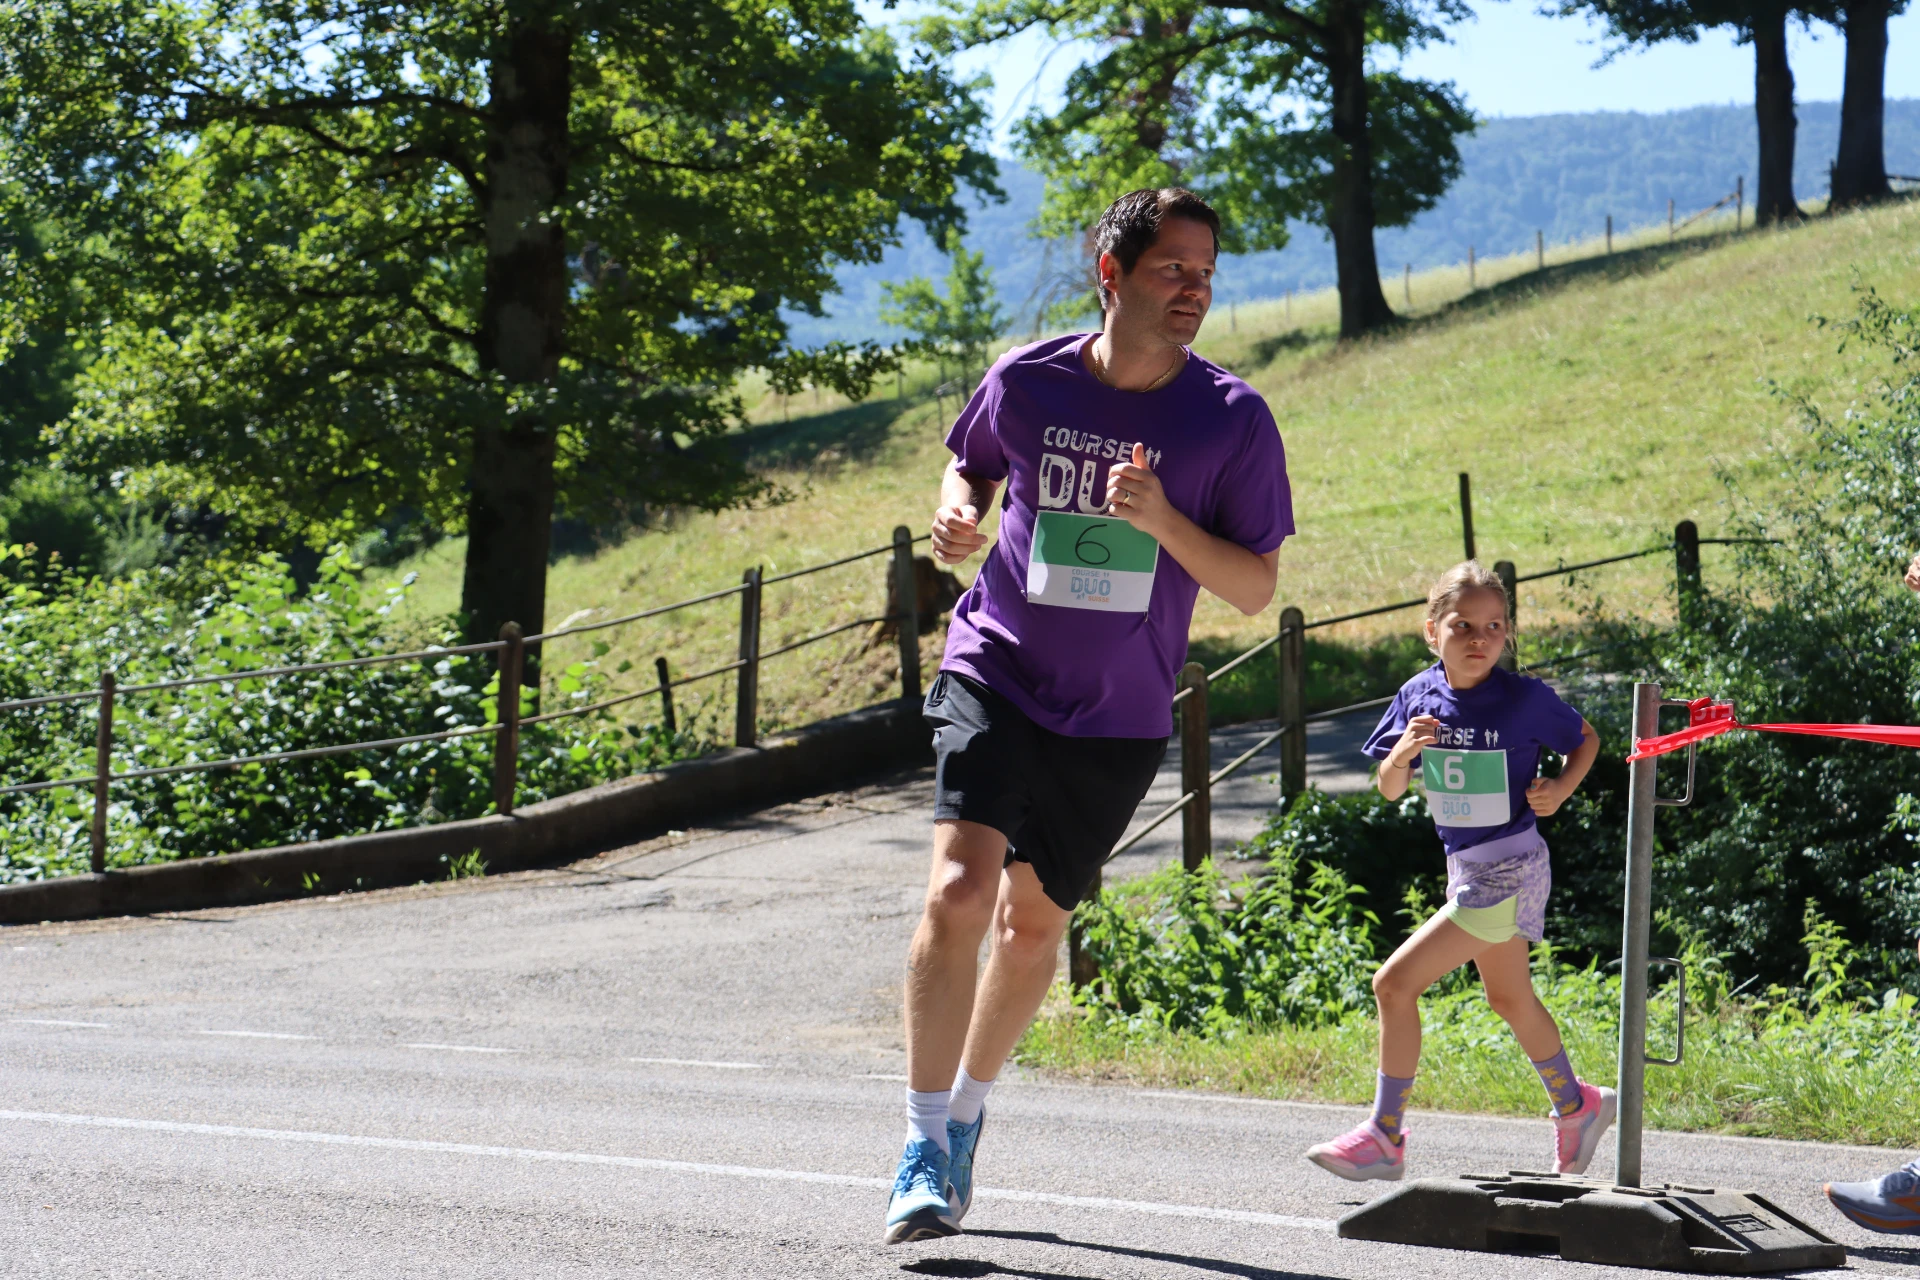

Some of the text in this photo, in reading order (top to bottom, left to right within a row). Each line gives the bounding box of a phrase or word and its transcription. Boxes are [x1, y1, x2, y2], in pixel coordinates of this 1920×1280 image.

[1043, 426, 1133, 462] COURSE
[1038, 452, 1111, 514] DU
[1076, 523, 1109, 565] 6
[1071, 568, 1100, 577] COURSE
[1071, 576, 1111, 596] DUO
[1436, 726, 1475, 746] RSE
[1444, 755, 1465, 790] 6
[1443, 801, 1471, 816] DUO
